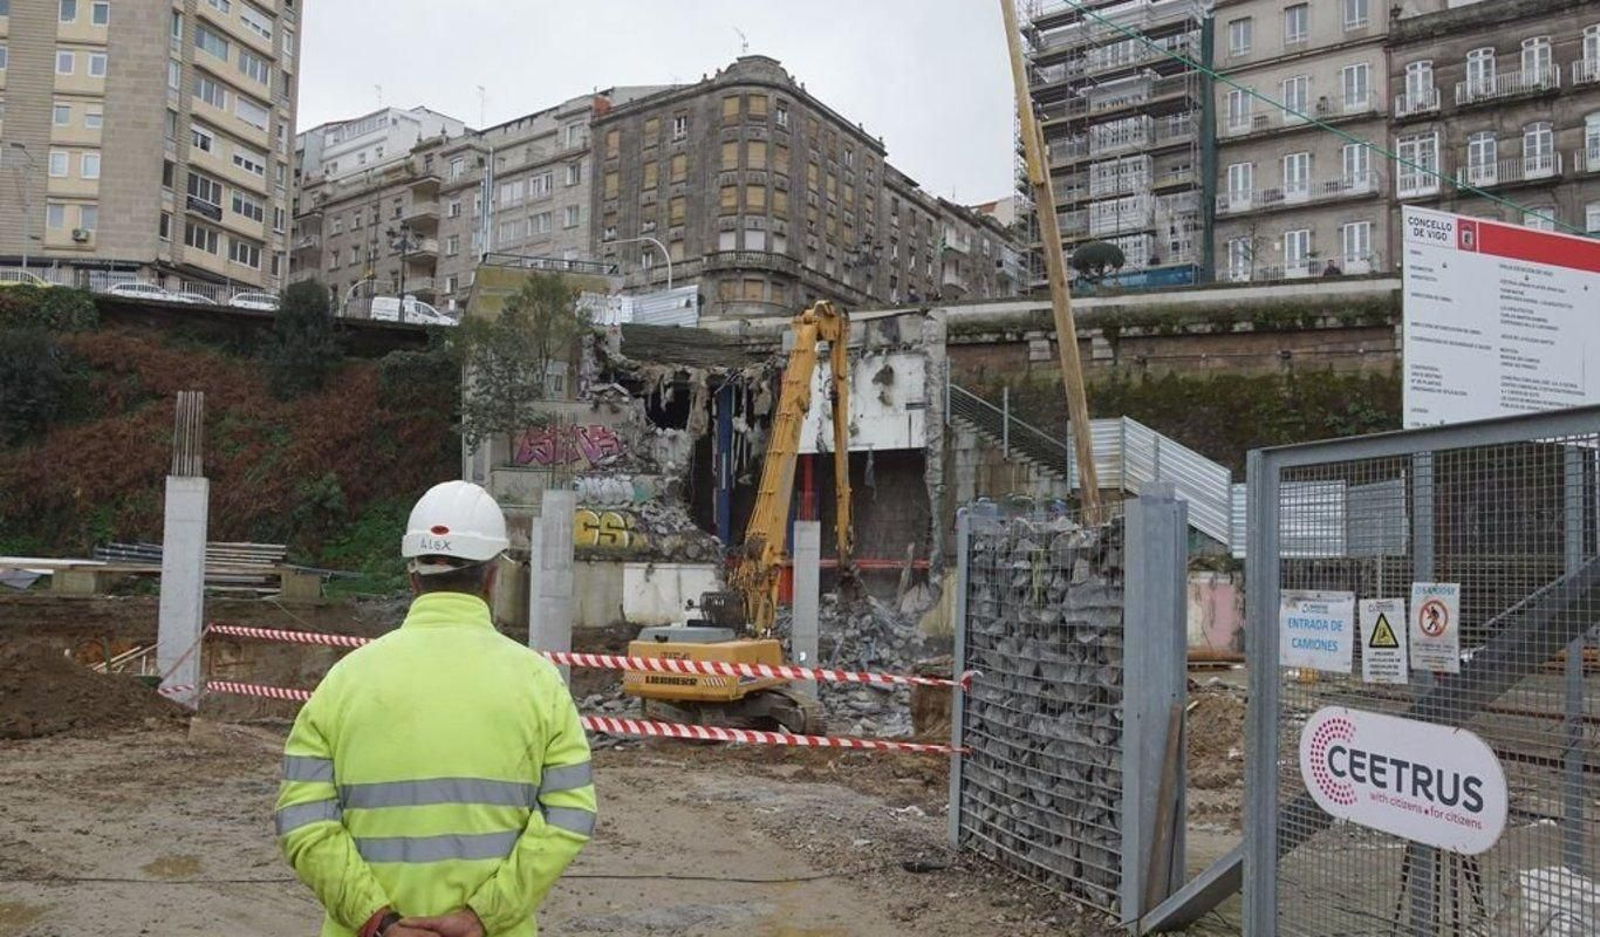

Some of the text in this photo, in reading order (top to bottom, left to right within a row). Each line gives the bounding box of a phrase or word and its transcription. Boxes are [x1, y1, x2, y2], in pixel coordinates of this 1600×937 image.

[1408, 216, 1452, 232] CONCELLO
[1413, 227, 1448, 241] DE VIGO
[1288, 617, 1344, 632] ENTRADA DE
[1291, 637, 1338, 652] CAMIONES
[1327, 745, 1484, 813] CEETRUS
[1370, 791, 1483, 830] with citizens for citizens
